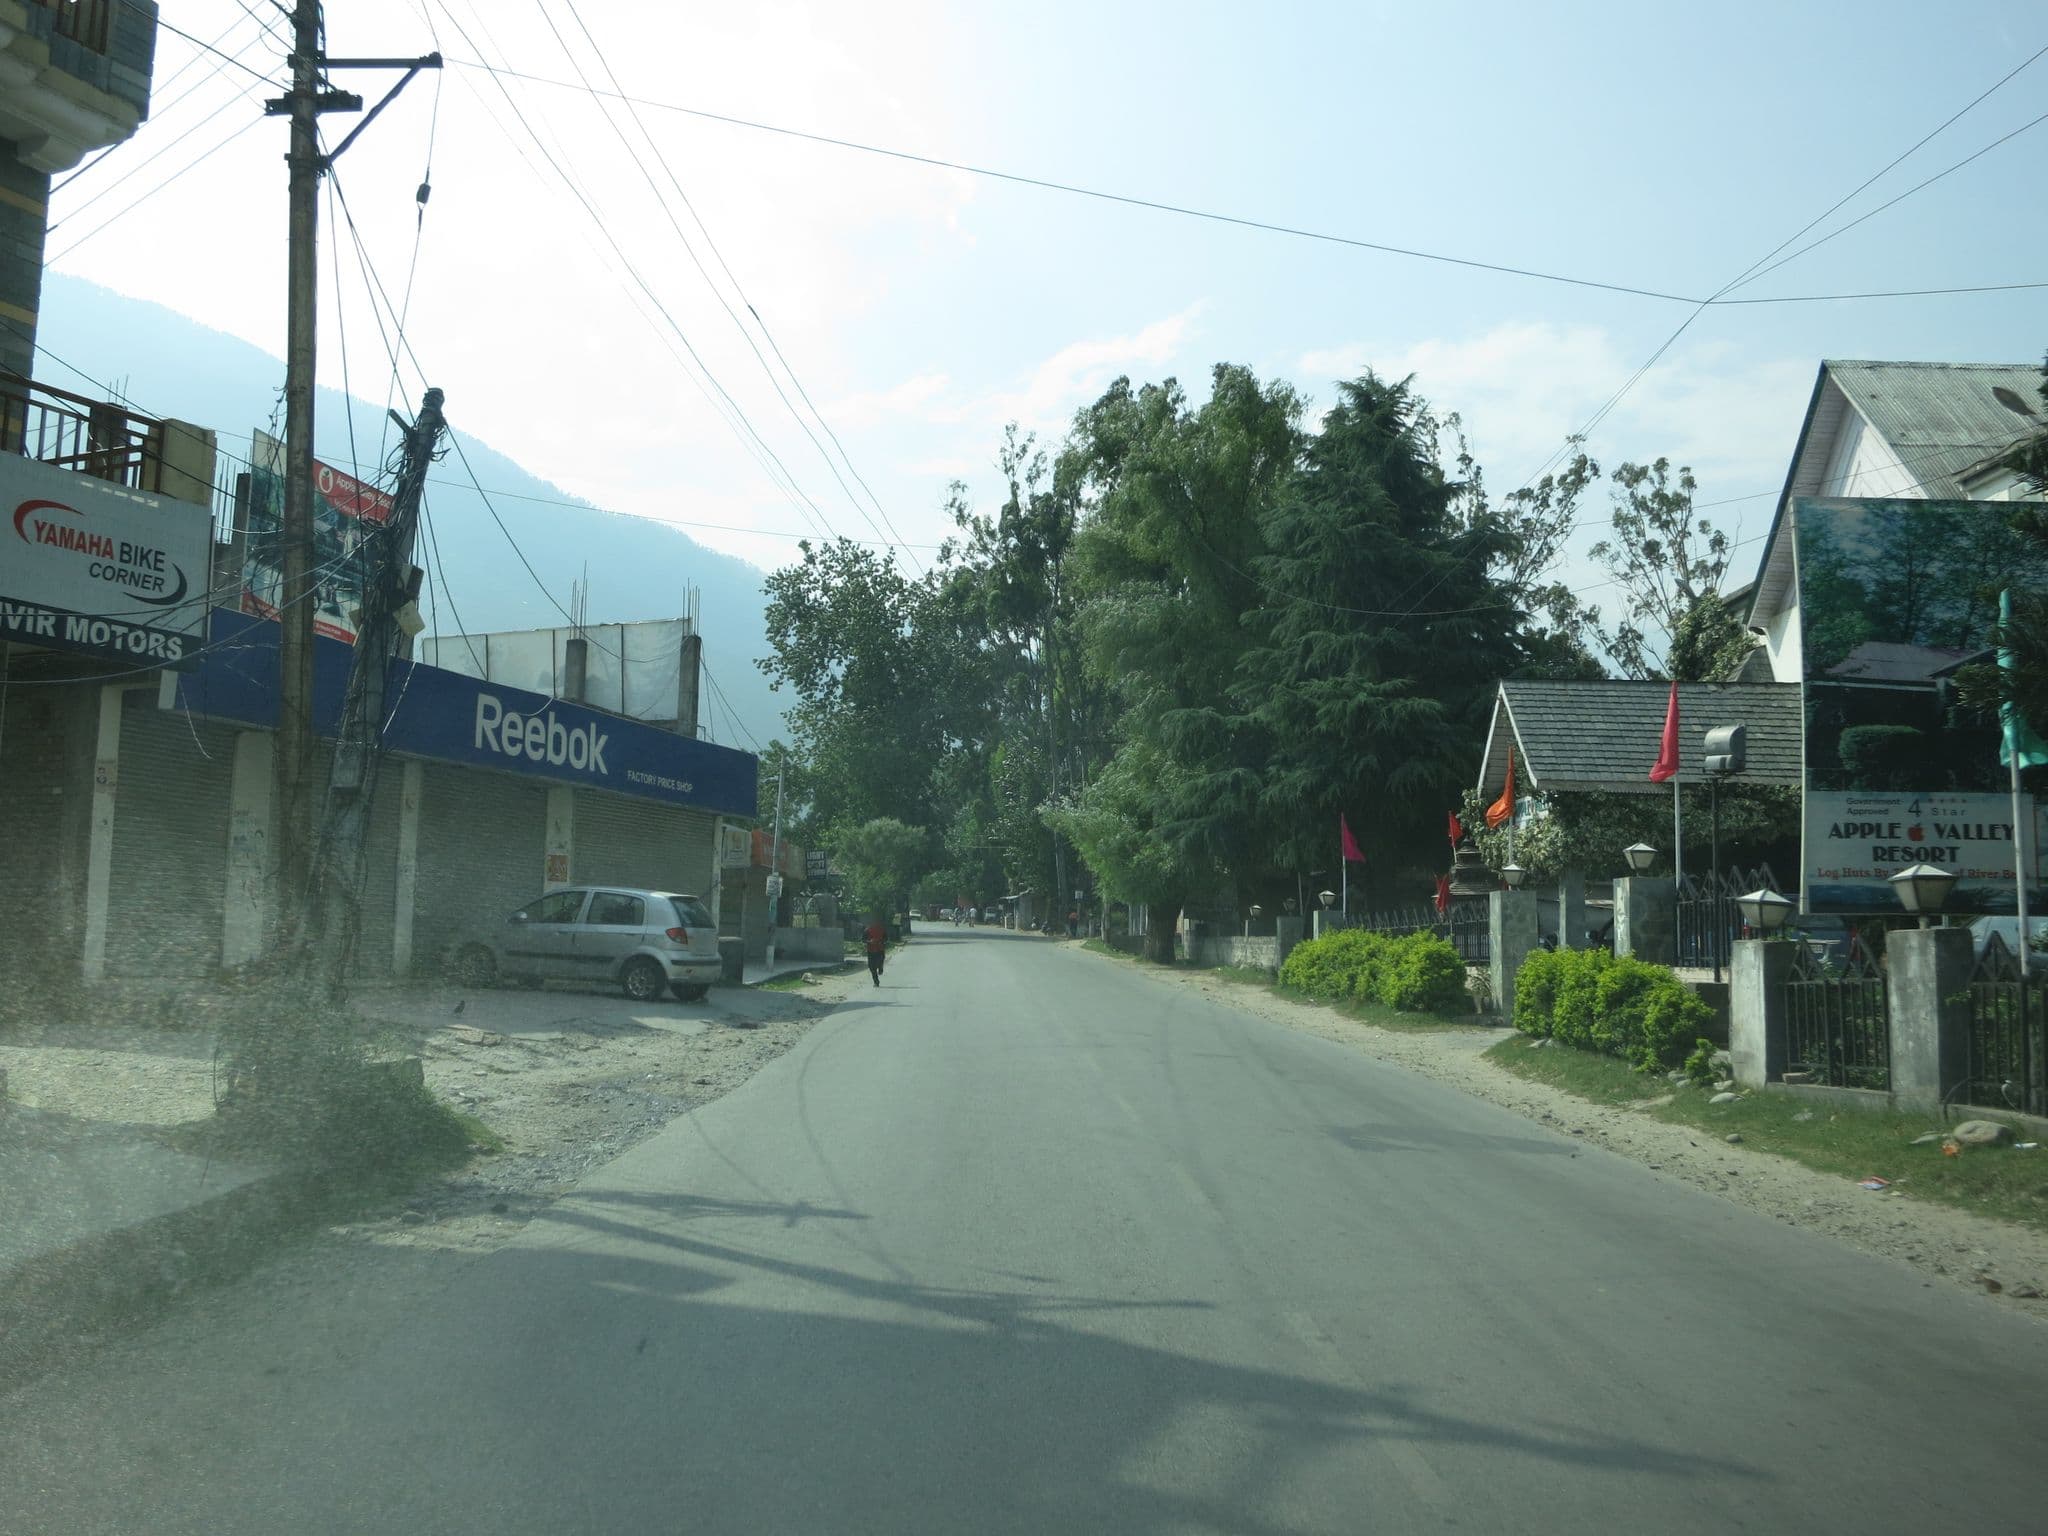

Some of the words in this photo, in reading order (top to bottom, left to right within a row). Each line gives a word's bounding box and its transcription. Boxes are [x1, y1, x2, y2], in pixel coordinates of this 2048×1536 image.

[34, 519, 114, 560] YAMAHA
[119, 542, 166, 572] BIKE
[89, 562, 165, 593] CORNER
[0, 601, 56, 638] VIR
[65, 615, 183, 661] MOTORS
[475, 692, 608, 775] Reebok
[627, 769, 657, 785] FACTORY
[657, 776, 676, 790] PRICE
[676, 781, 694, 793] SHOP
[1847, 807, 1889, 816] Approved
[1907, 799, 1922, 817] 4
[1930, 807, 1967, 817] Star
[1828, 822, 1902, 840] APPLE
[1933, 823, 2015, 841] VALLEY
[1872, 846, 1960, 863] RESORT
[1817, 867, 1840, 881] Log
[1842, 867, 1871, 879] Huts
[1873, 867, 1889, 881] By
[1967, 868, 2000, 880] River
